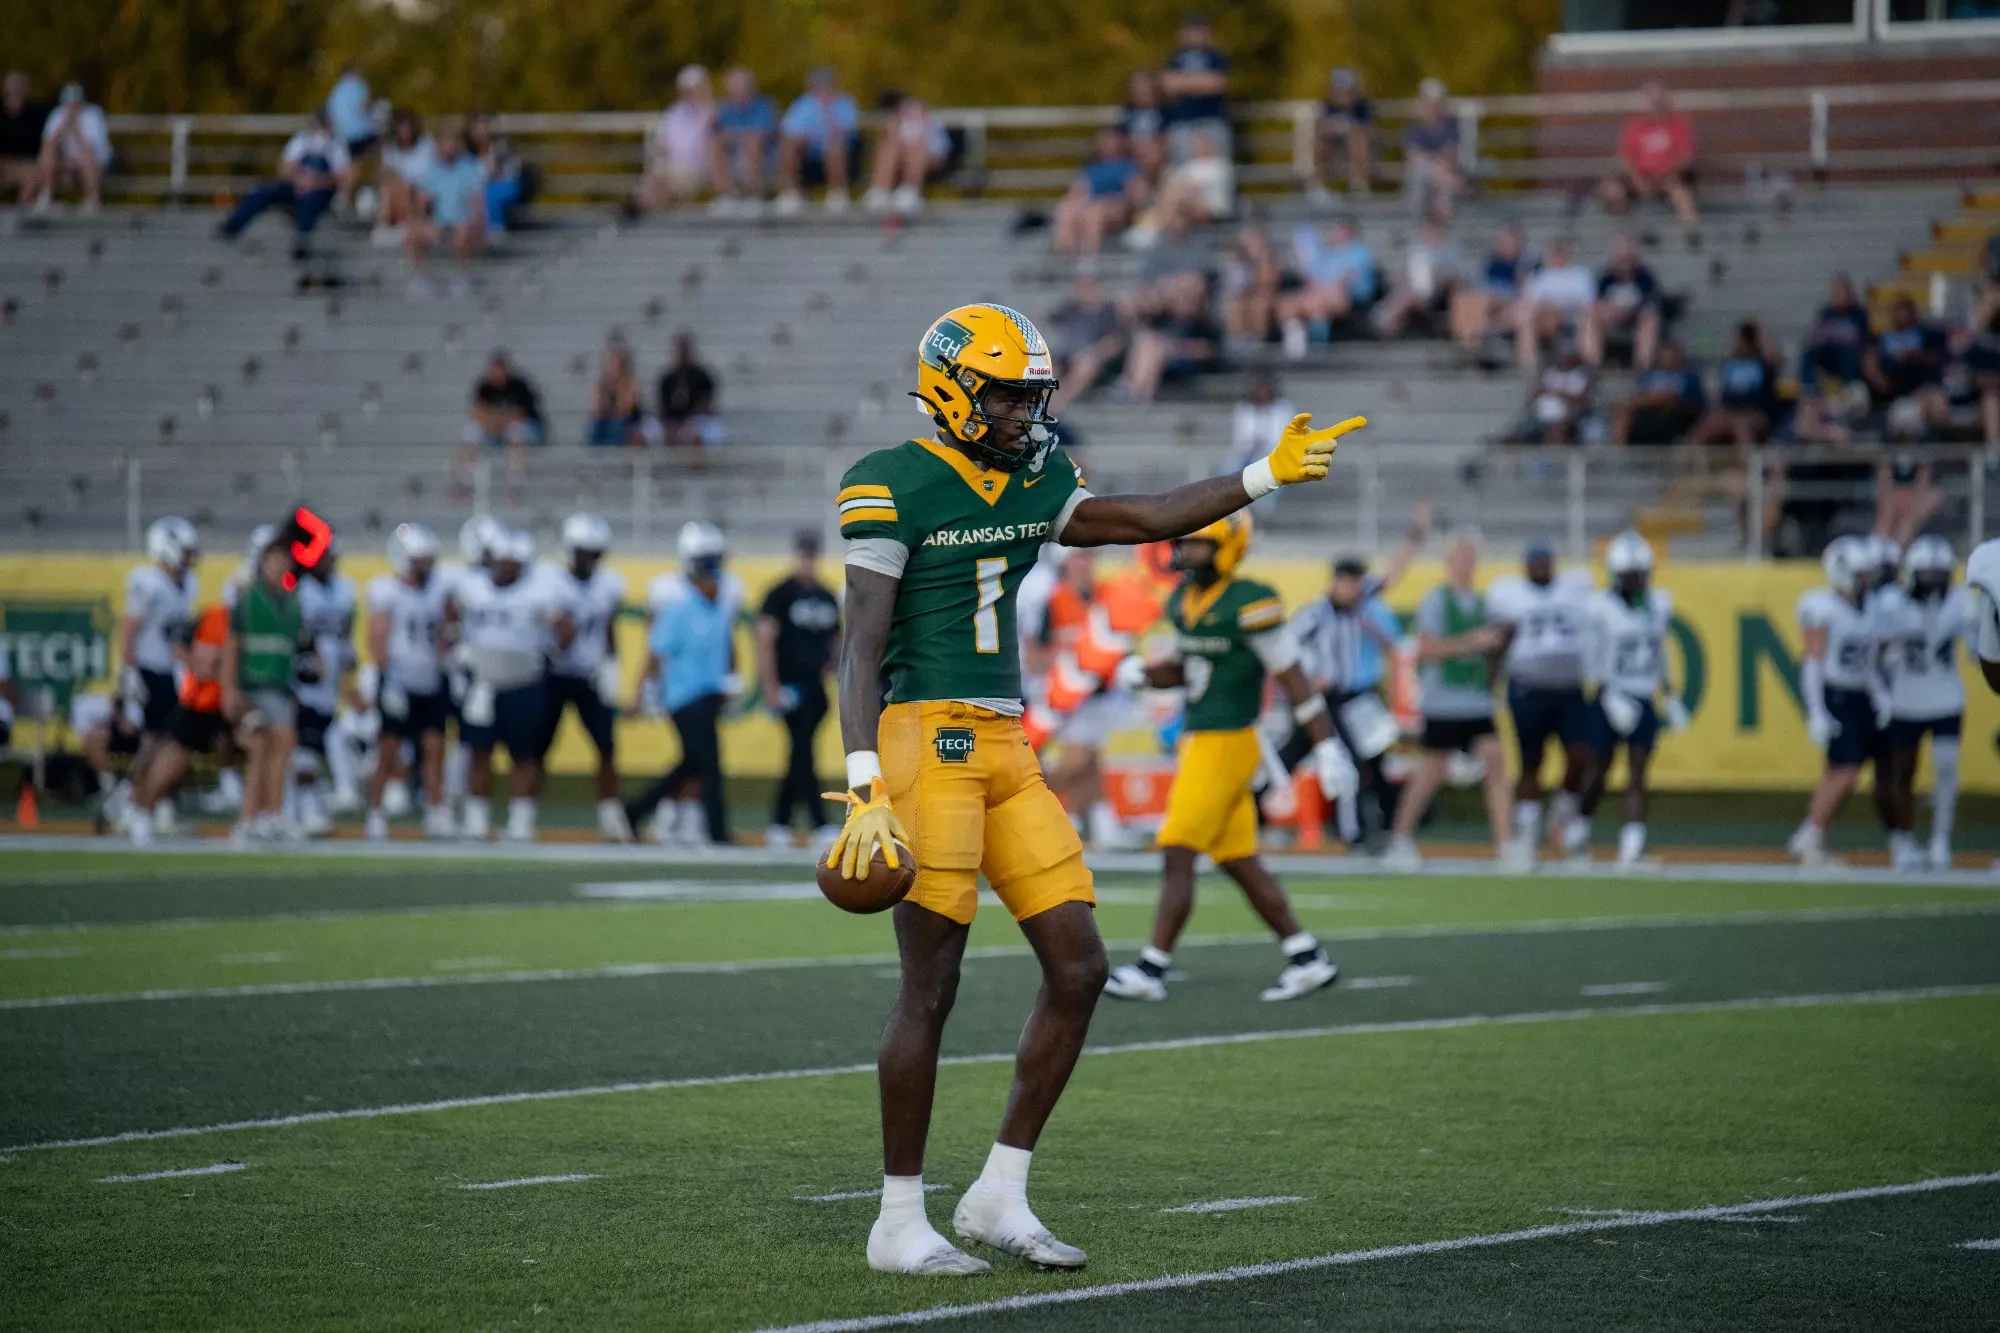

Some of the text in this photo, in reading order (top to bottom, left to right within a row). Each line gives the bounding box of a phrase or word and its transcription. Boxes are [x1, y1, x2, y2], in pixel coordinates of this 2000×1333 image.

[929, 330, 962, 358] TECH
[922, 525, 1015, 546] ARKANSAS
[974, 557, 1008, 653] 1
[935, 738, 973, 750] TECH
